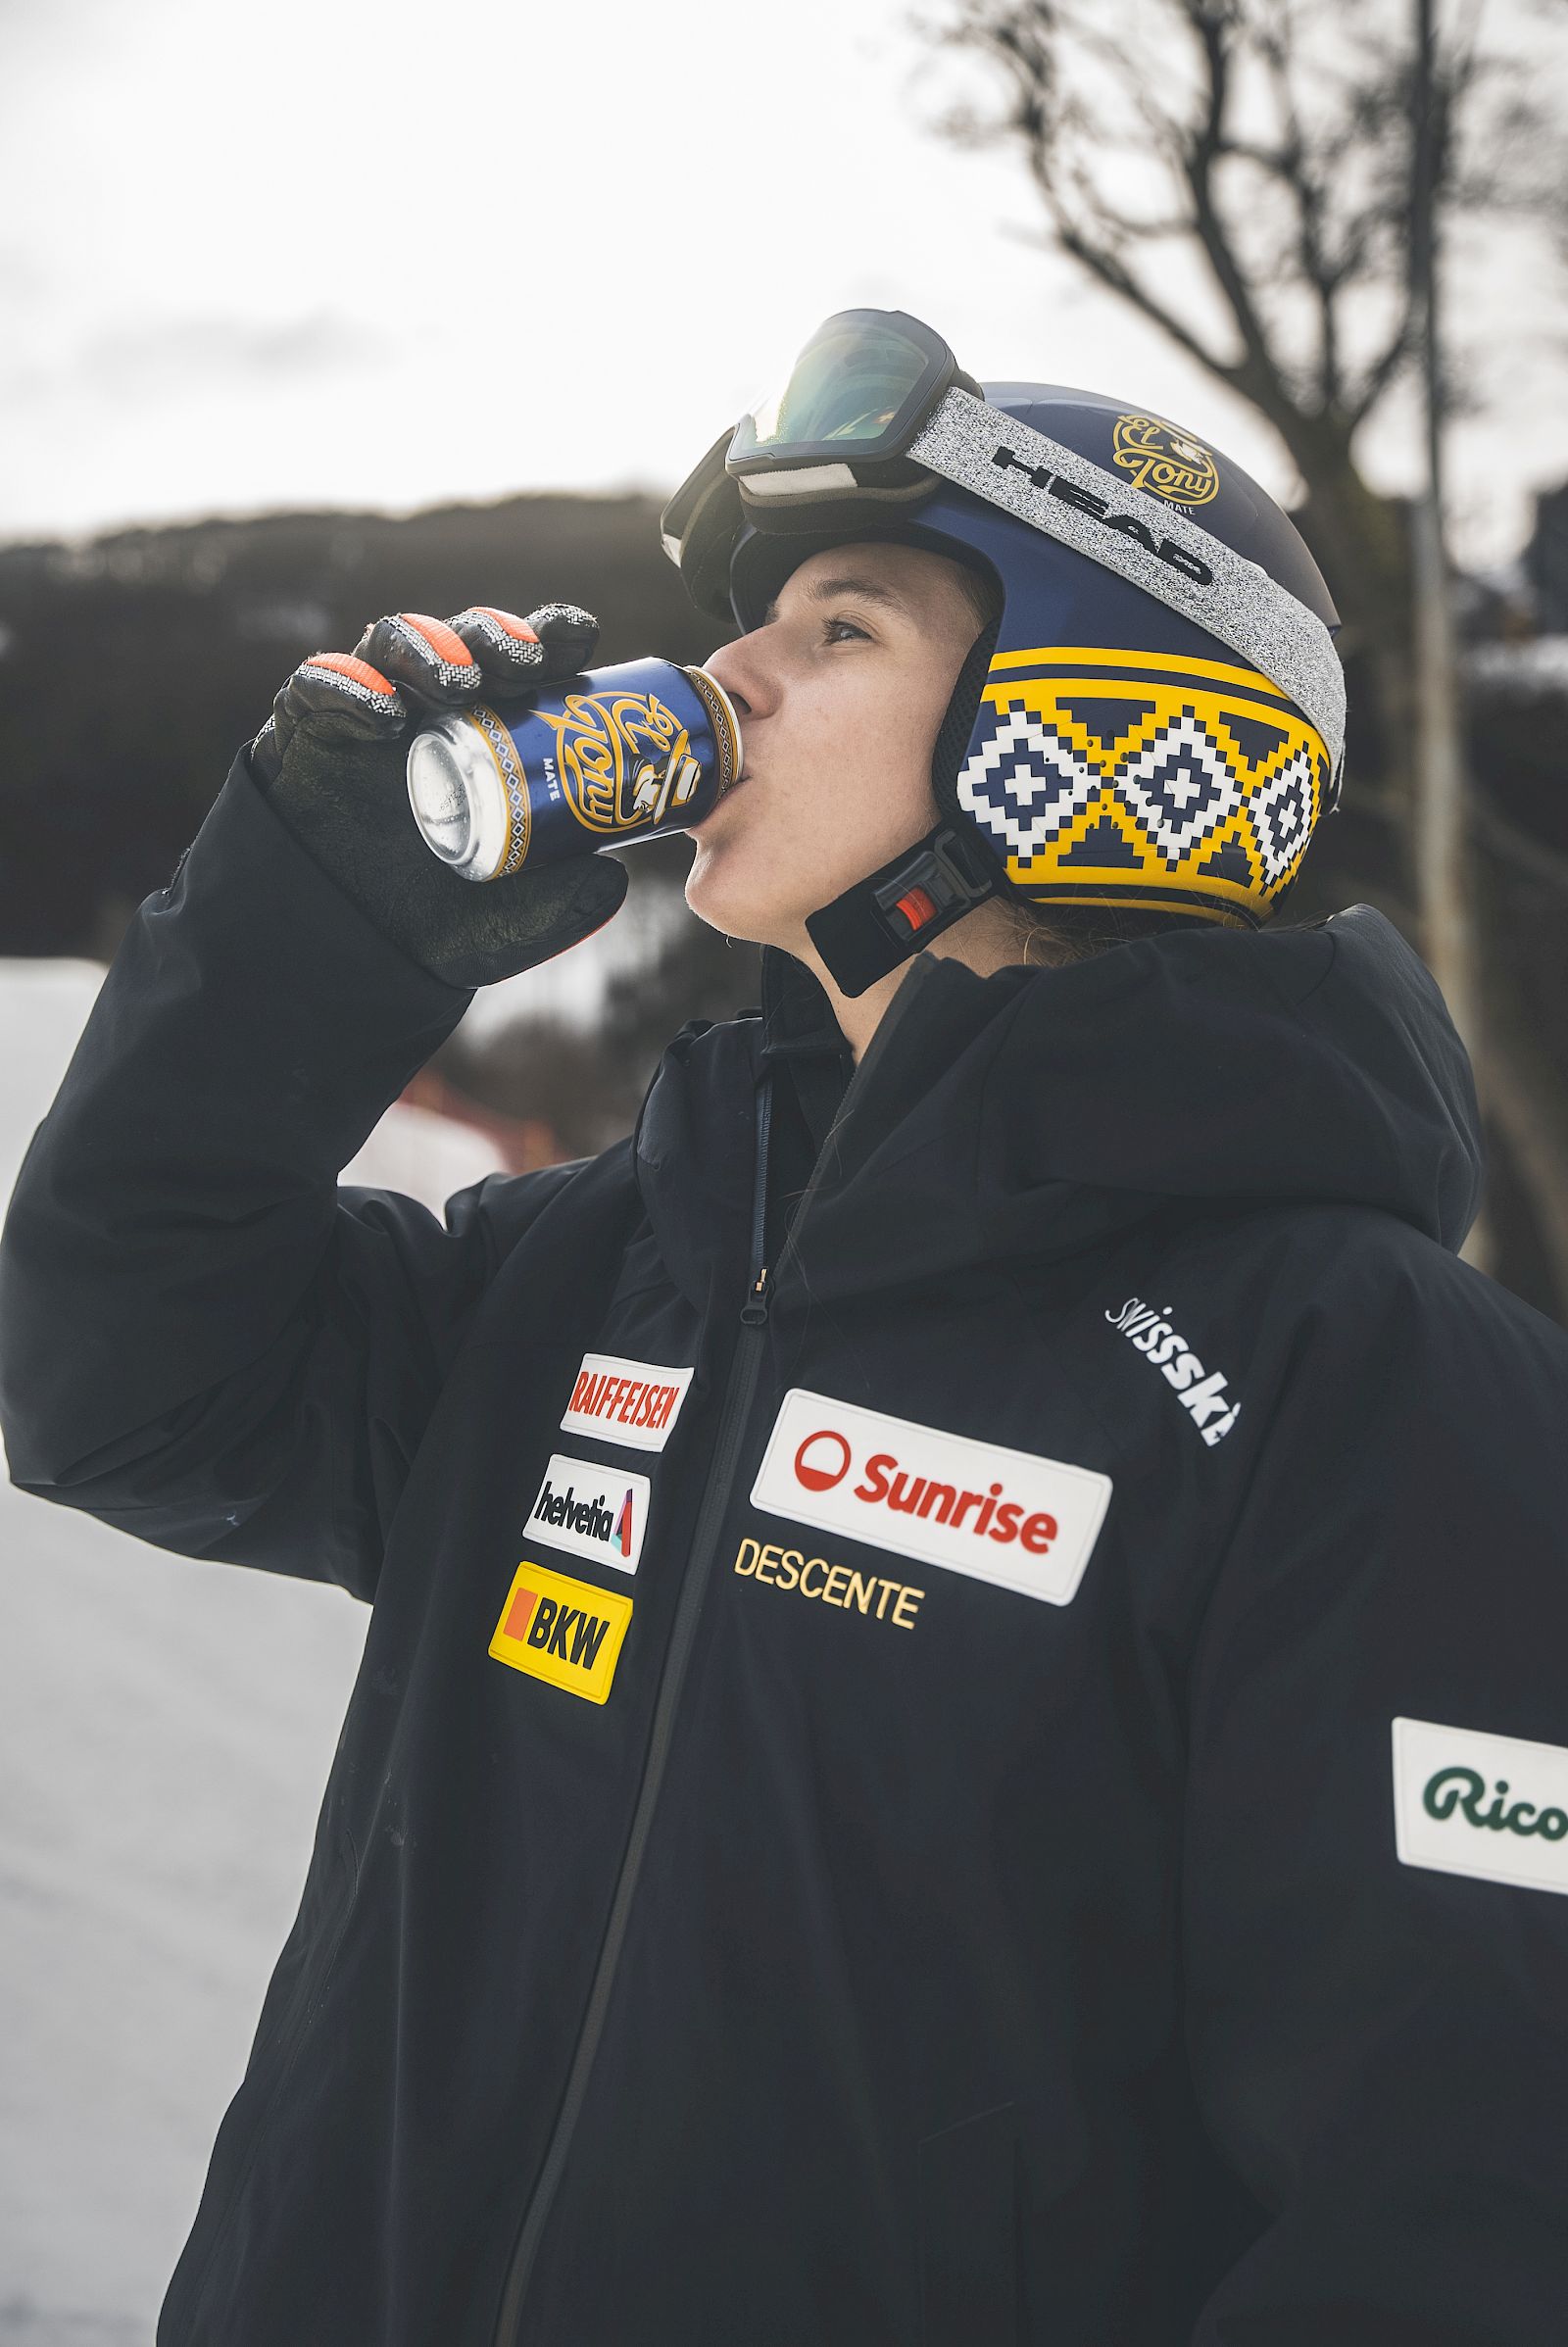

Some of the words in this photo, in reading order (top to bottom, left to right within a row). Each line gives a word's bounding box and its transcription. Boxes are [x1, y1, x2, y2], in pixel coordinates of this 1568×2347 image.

[1117, 416, 1163, 450] El
[1113, 448, 1213, 498] Tony
[992, 446, 1213, 586] HEAD
[1162, 500, 1196, 515] MATE
[612, 693, 674, 755] El
[528, 695, 643, 825] Tony
[543, 758, 561, 802] MATE
[568, 1372, 679, 1429] RAIFFEISEN
[534, 1481, 613, 1541] helvetia
[854, 1454, 1058, 1555] Sunrise
[734, 1538, 926, 1631] DESCENTE
[527, 1597, 611, 1670] BKW
[1423, 1767, 1568, 1841] Rico
